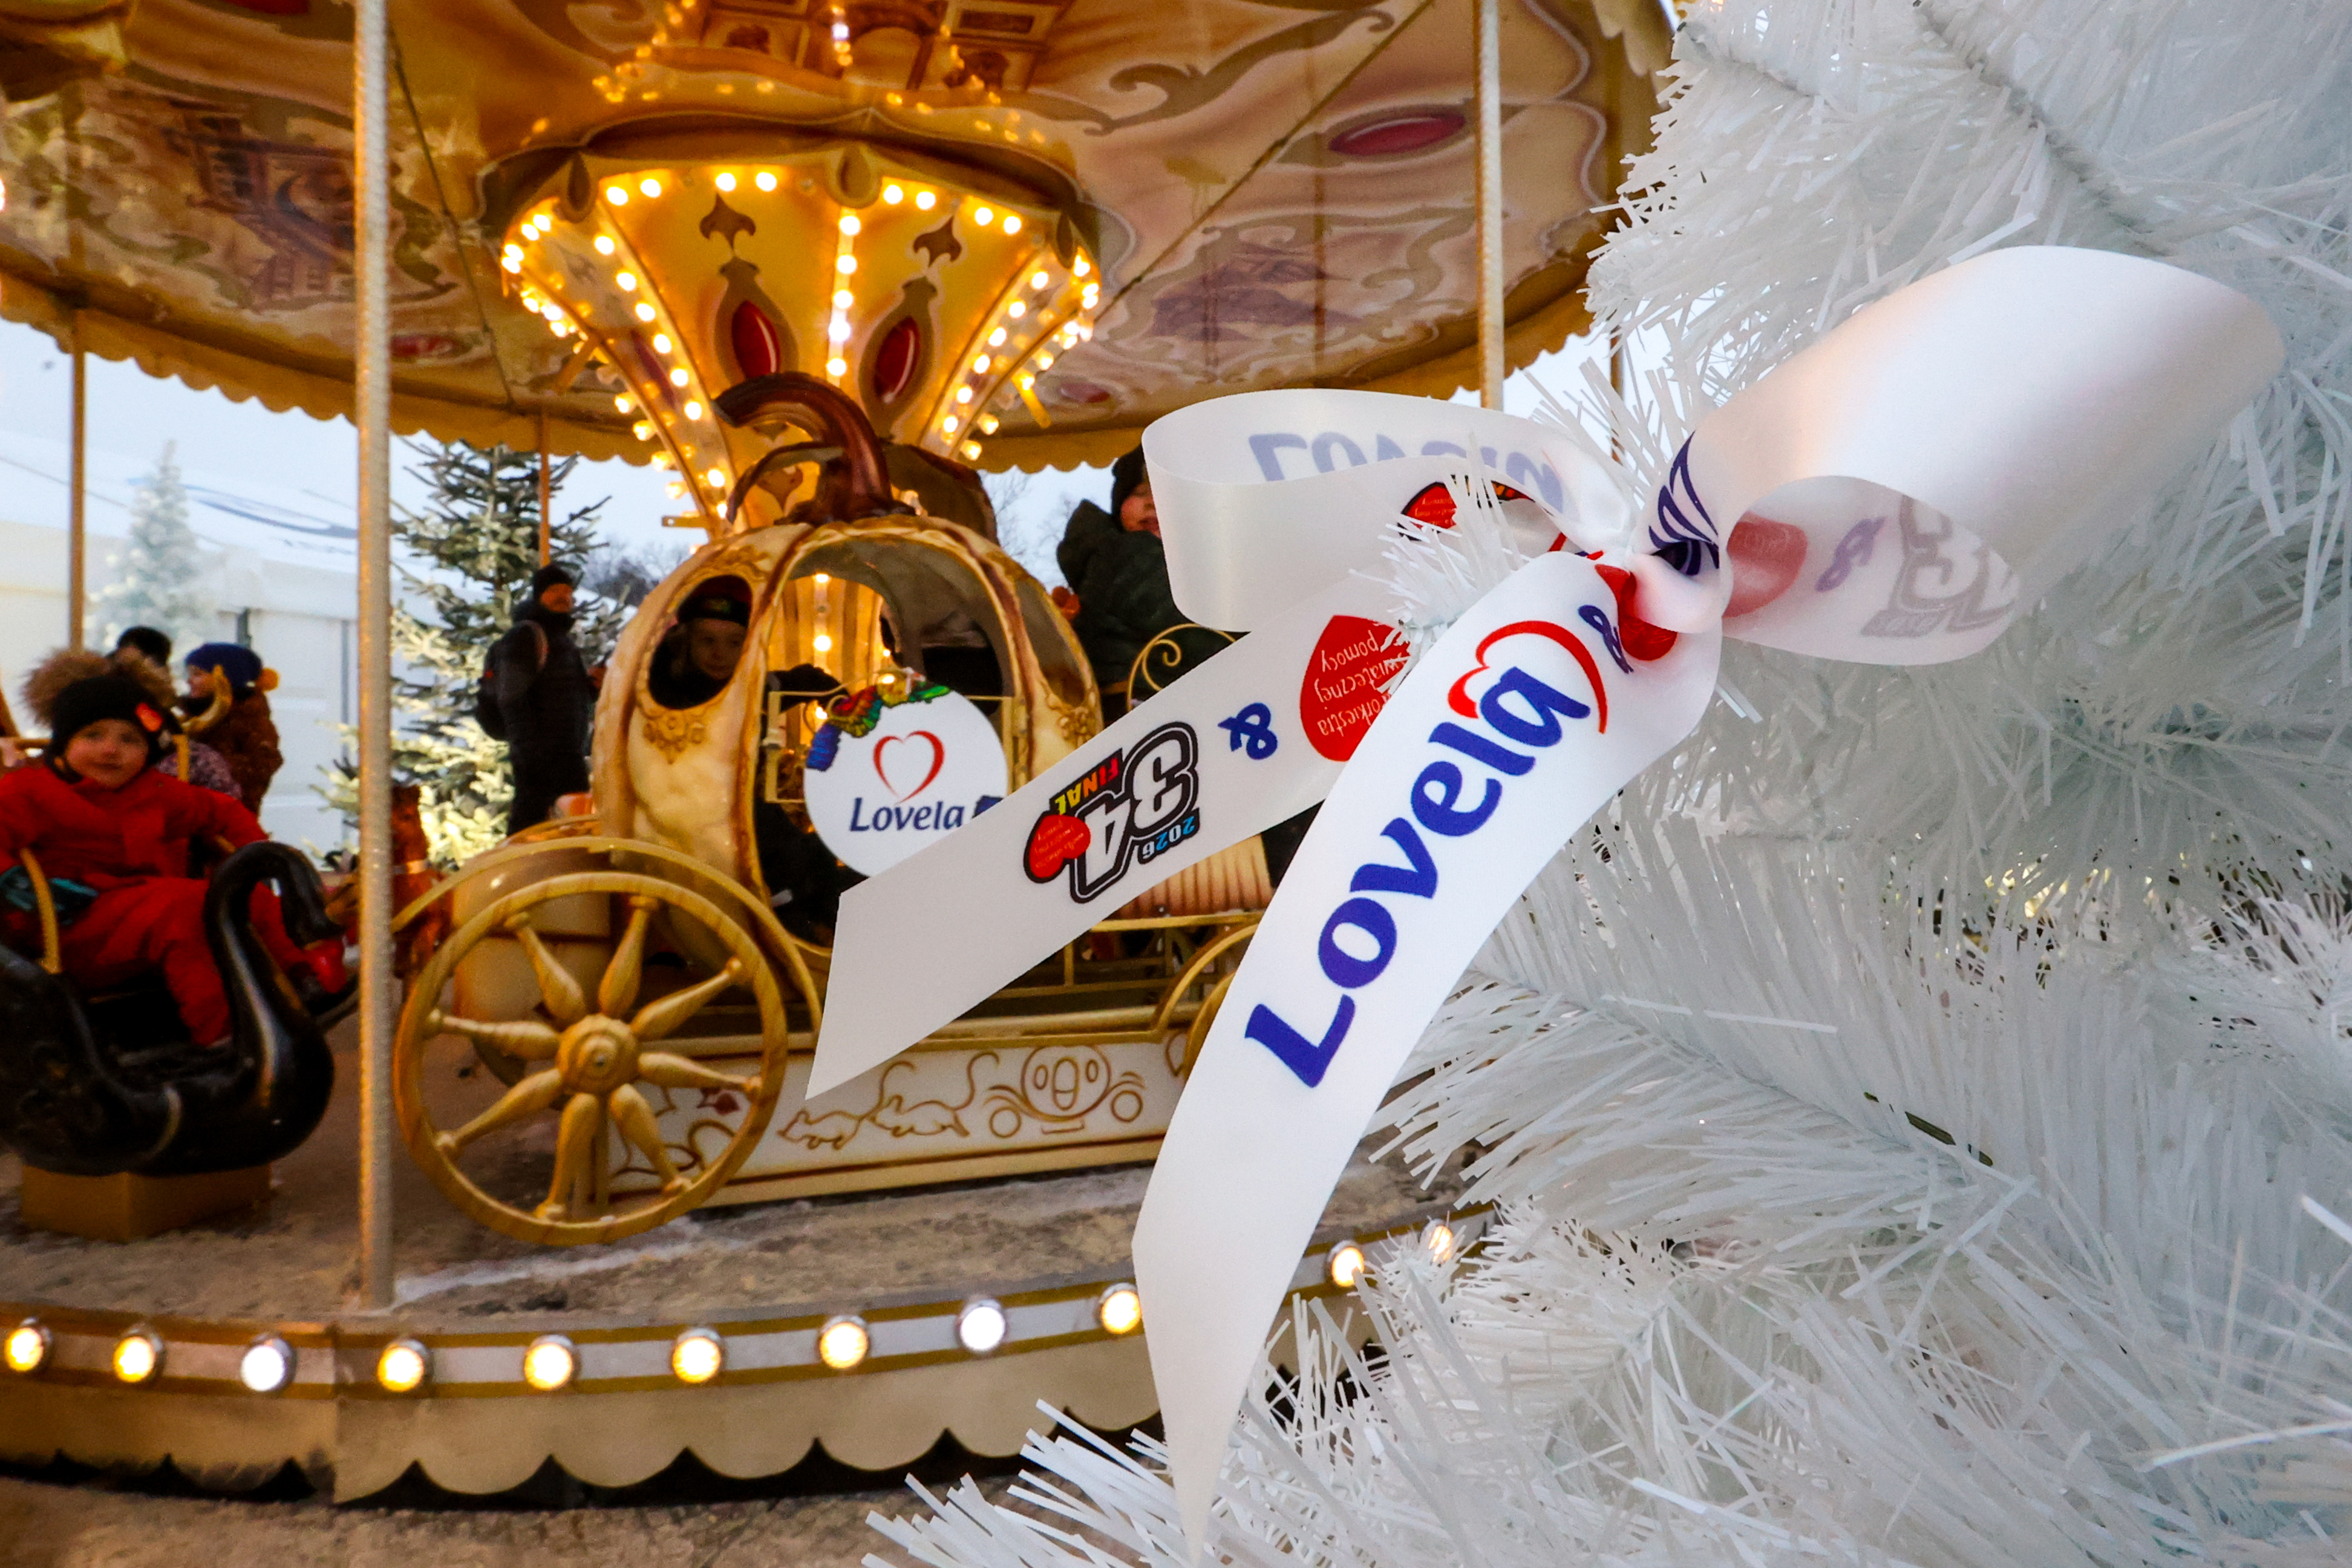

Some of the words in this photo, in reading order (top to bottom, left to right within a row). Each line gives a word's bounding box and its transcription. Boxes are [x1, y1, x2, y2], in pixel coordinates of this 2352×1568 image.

[1321, 630, 1379, 673] pomocy
[1317, 699, 1380, 737] orkiestra
[849, 797, 965, 832] Lovela
[1076, 729, 1193, 897] 34
[1143, 815, 1195, 859] 2026
[1244, 665, 1590, 1088] Lovela
